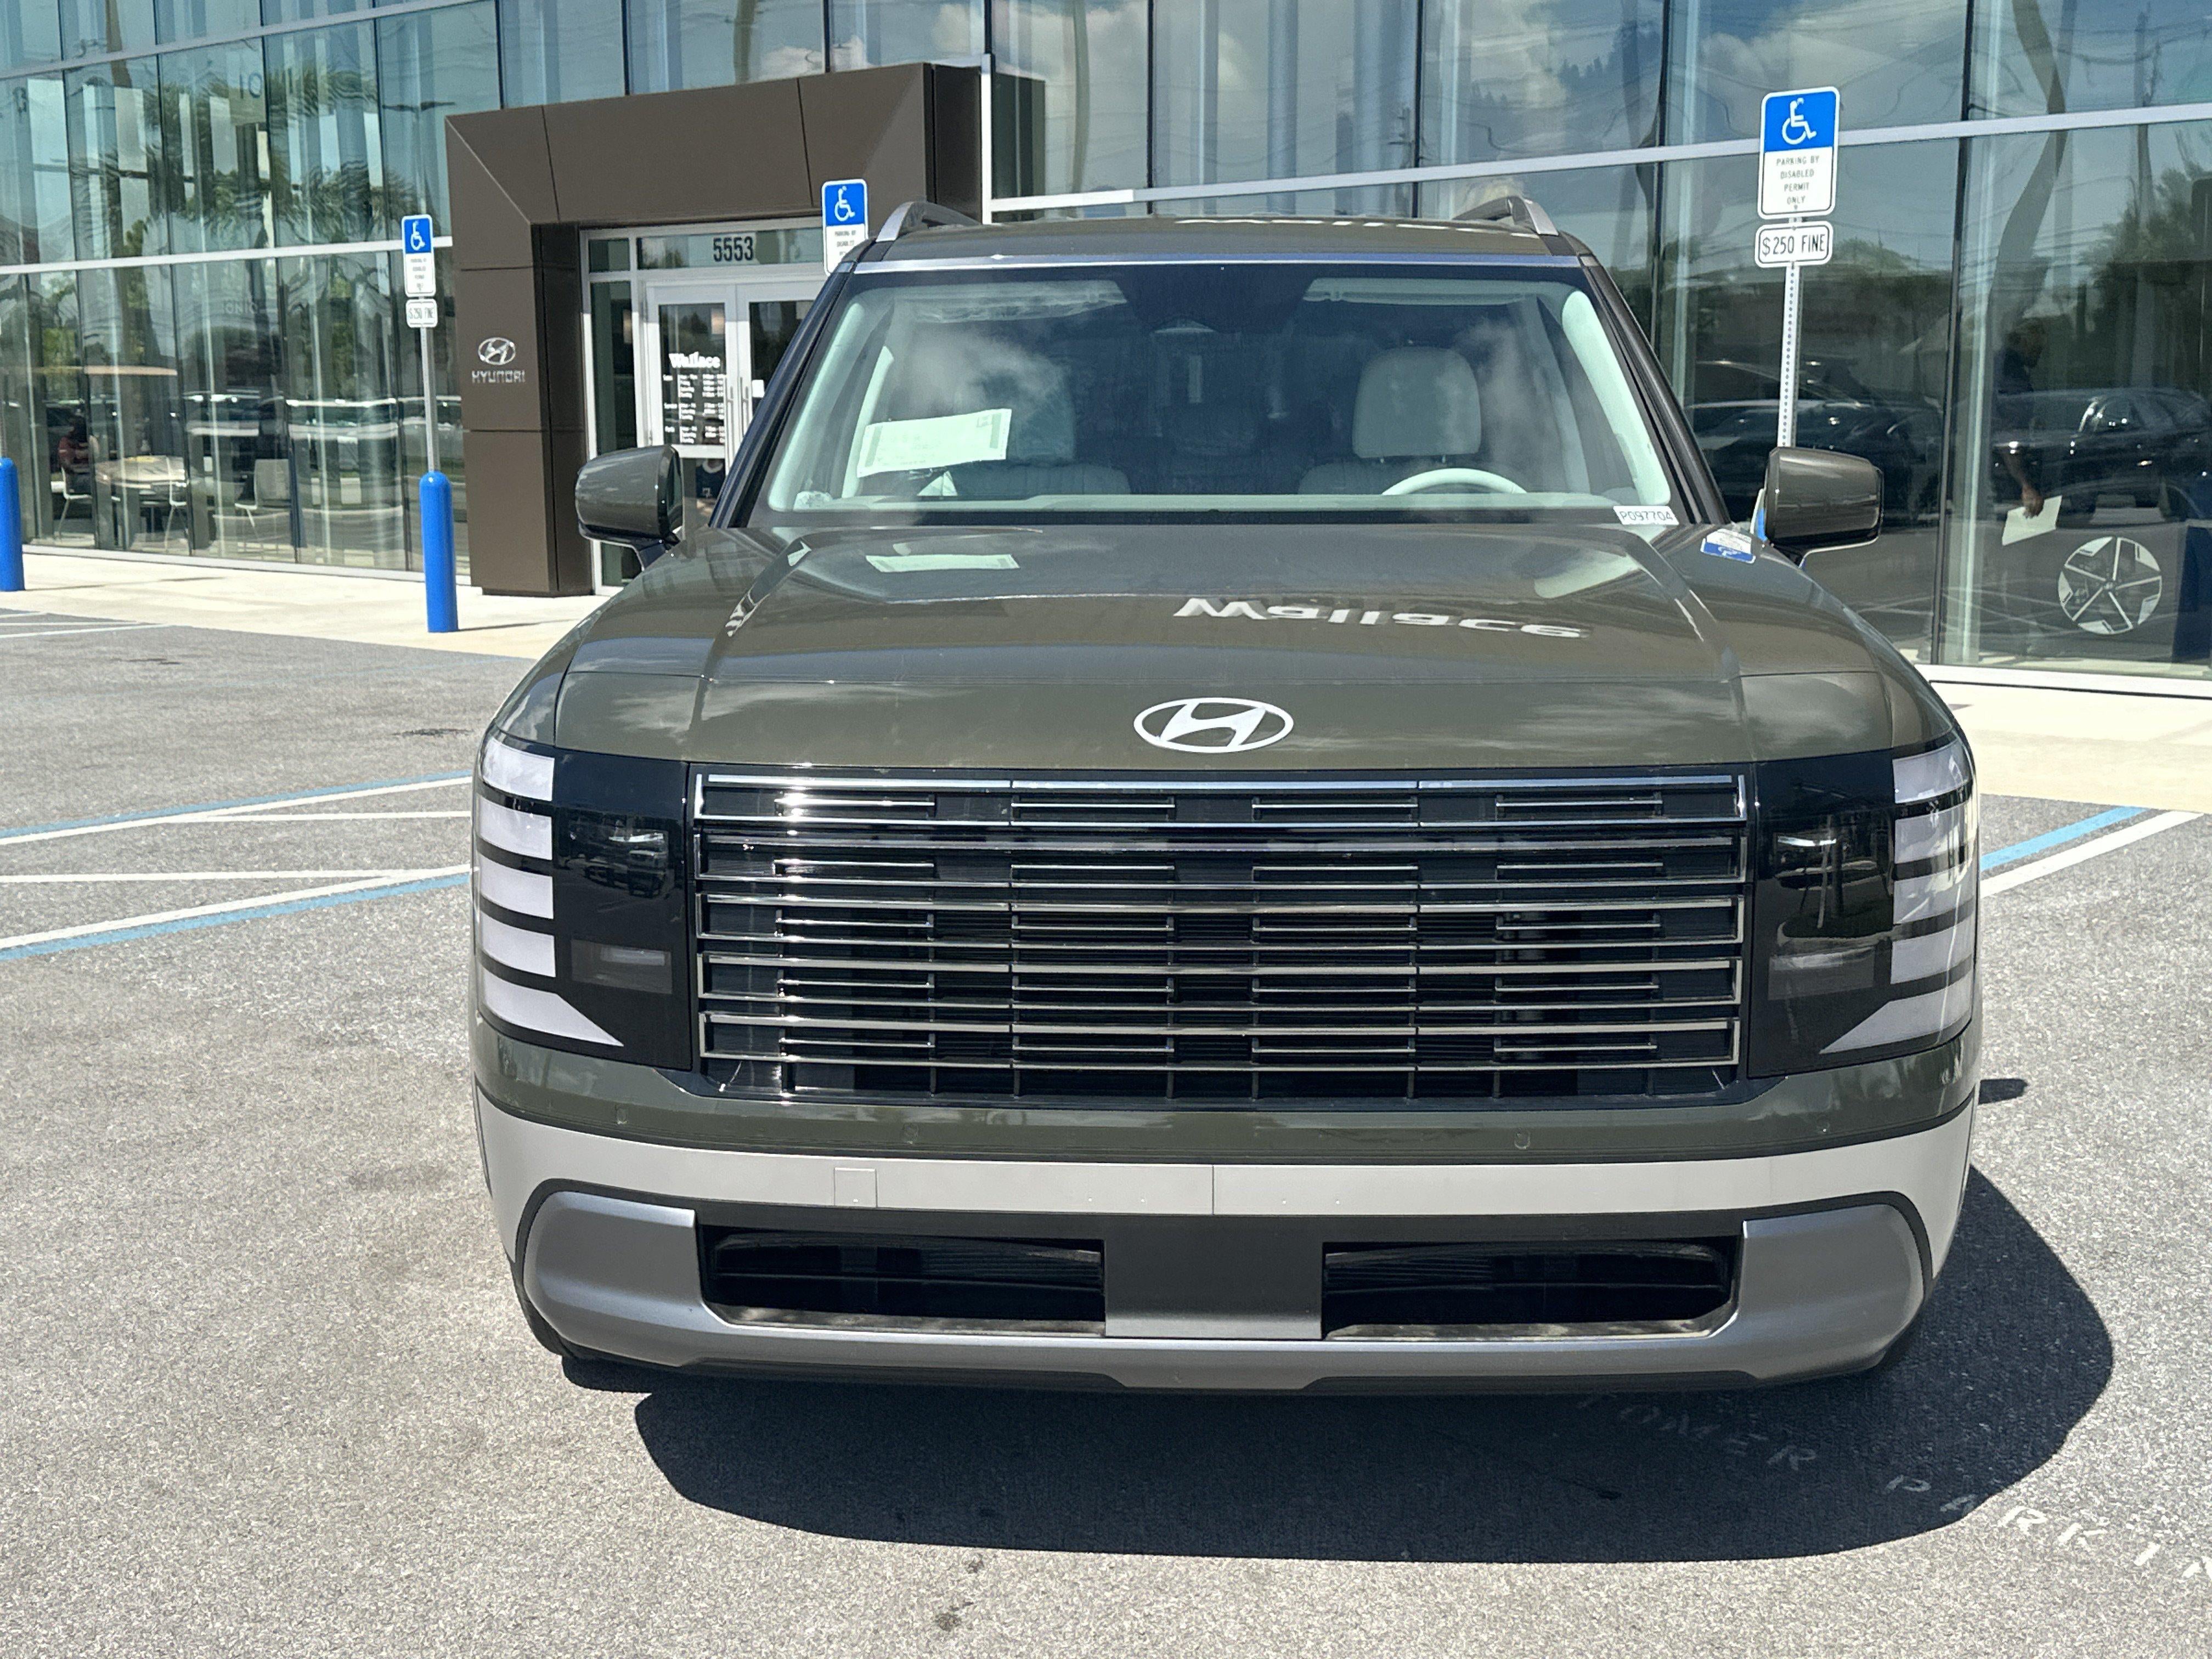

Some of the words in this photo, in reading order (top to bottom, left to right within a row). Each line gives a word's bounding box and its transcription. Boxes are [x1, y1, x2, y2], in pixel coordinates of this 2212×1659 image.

[1776, 157, 1807, 166] PARKING
[1810, 155, 1819, 163] BY
[1781, 169, 1814, 179] DISABLED
[1784, 183, 1810, 192] PERMIT
[1787, 196, 1806, 205] ONLY
[713, 236, 754, 262] 5553
[1762, 236, 1795, 256] $250
[1801, 233, 1825, 253] FINE
[669, 351, 721, 368] Wallace
[472, 370, 526, 383] HYUNDAI
